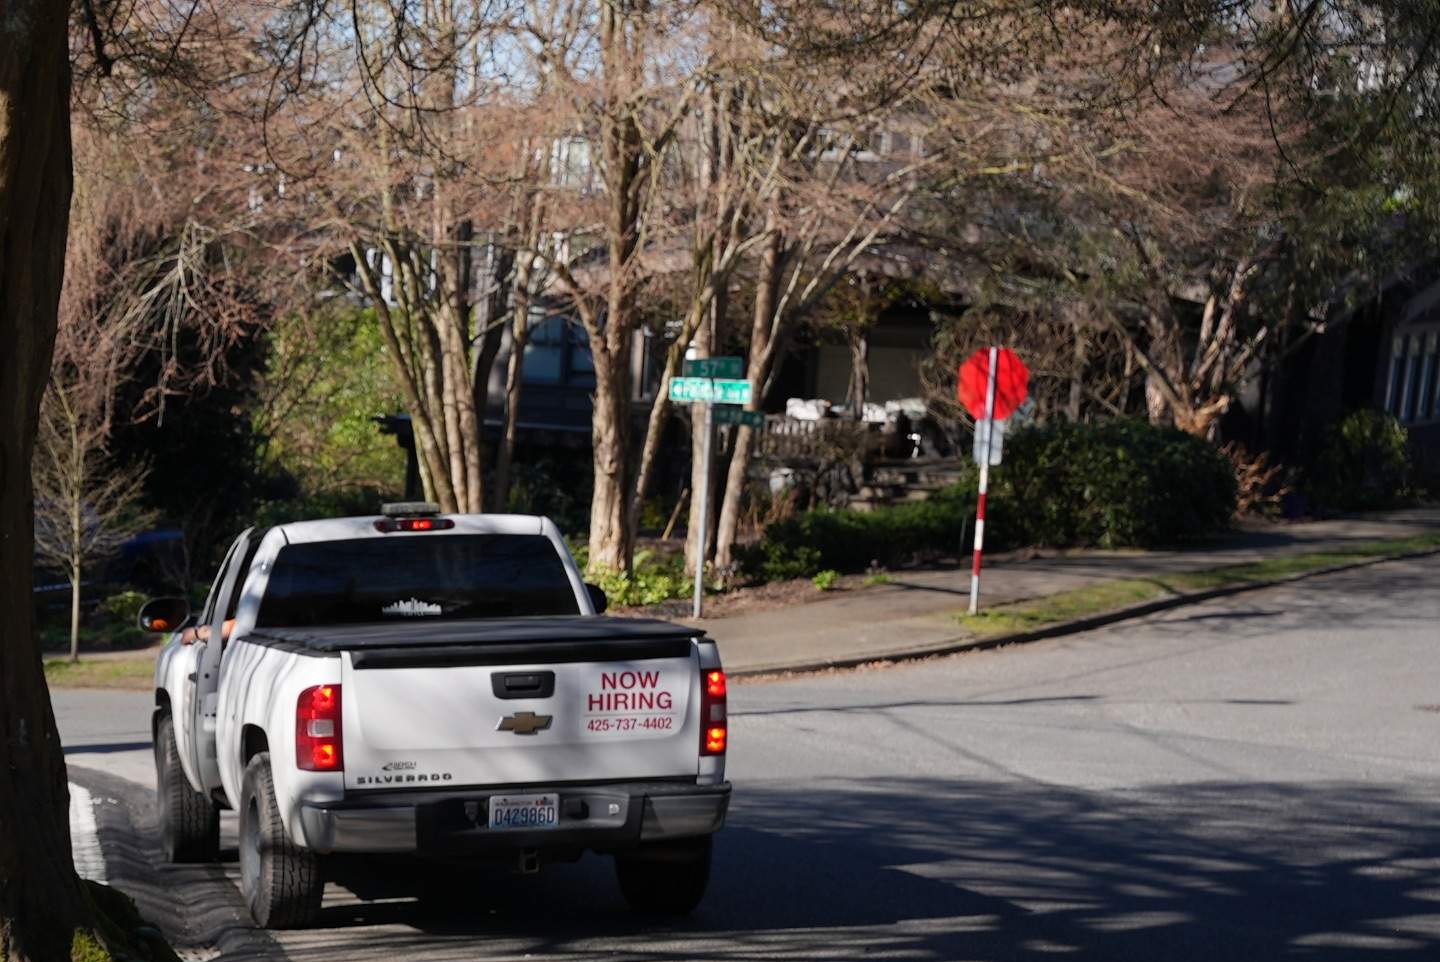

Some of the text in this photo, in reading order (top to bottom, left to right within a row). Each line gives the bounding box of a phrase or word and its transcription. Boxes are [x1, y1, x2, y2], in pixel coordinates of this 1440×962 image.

[601, 671, 660, 690] NOW
[588, 691, 672, 712] HIRING
[587, 717, 672, 732] 425-737-4402
[357, 773, 452, 785] SILVERADO
